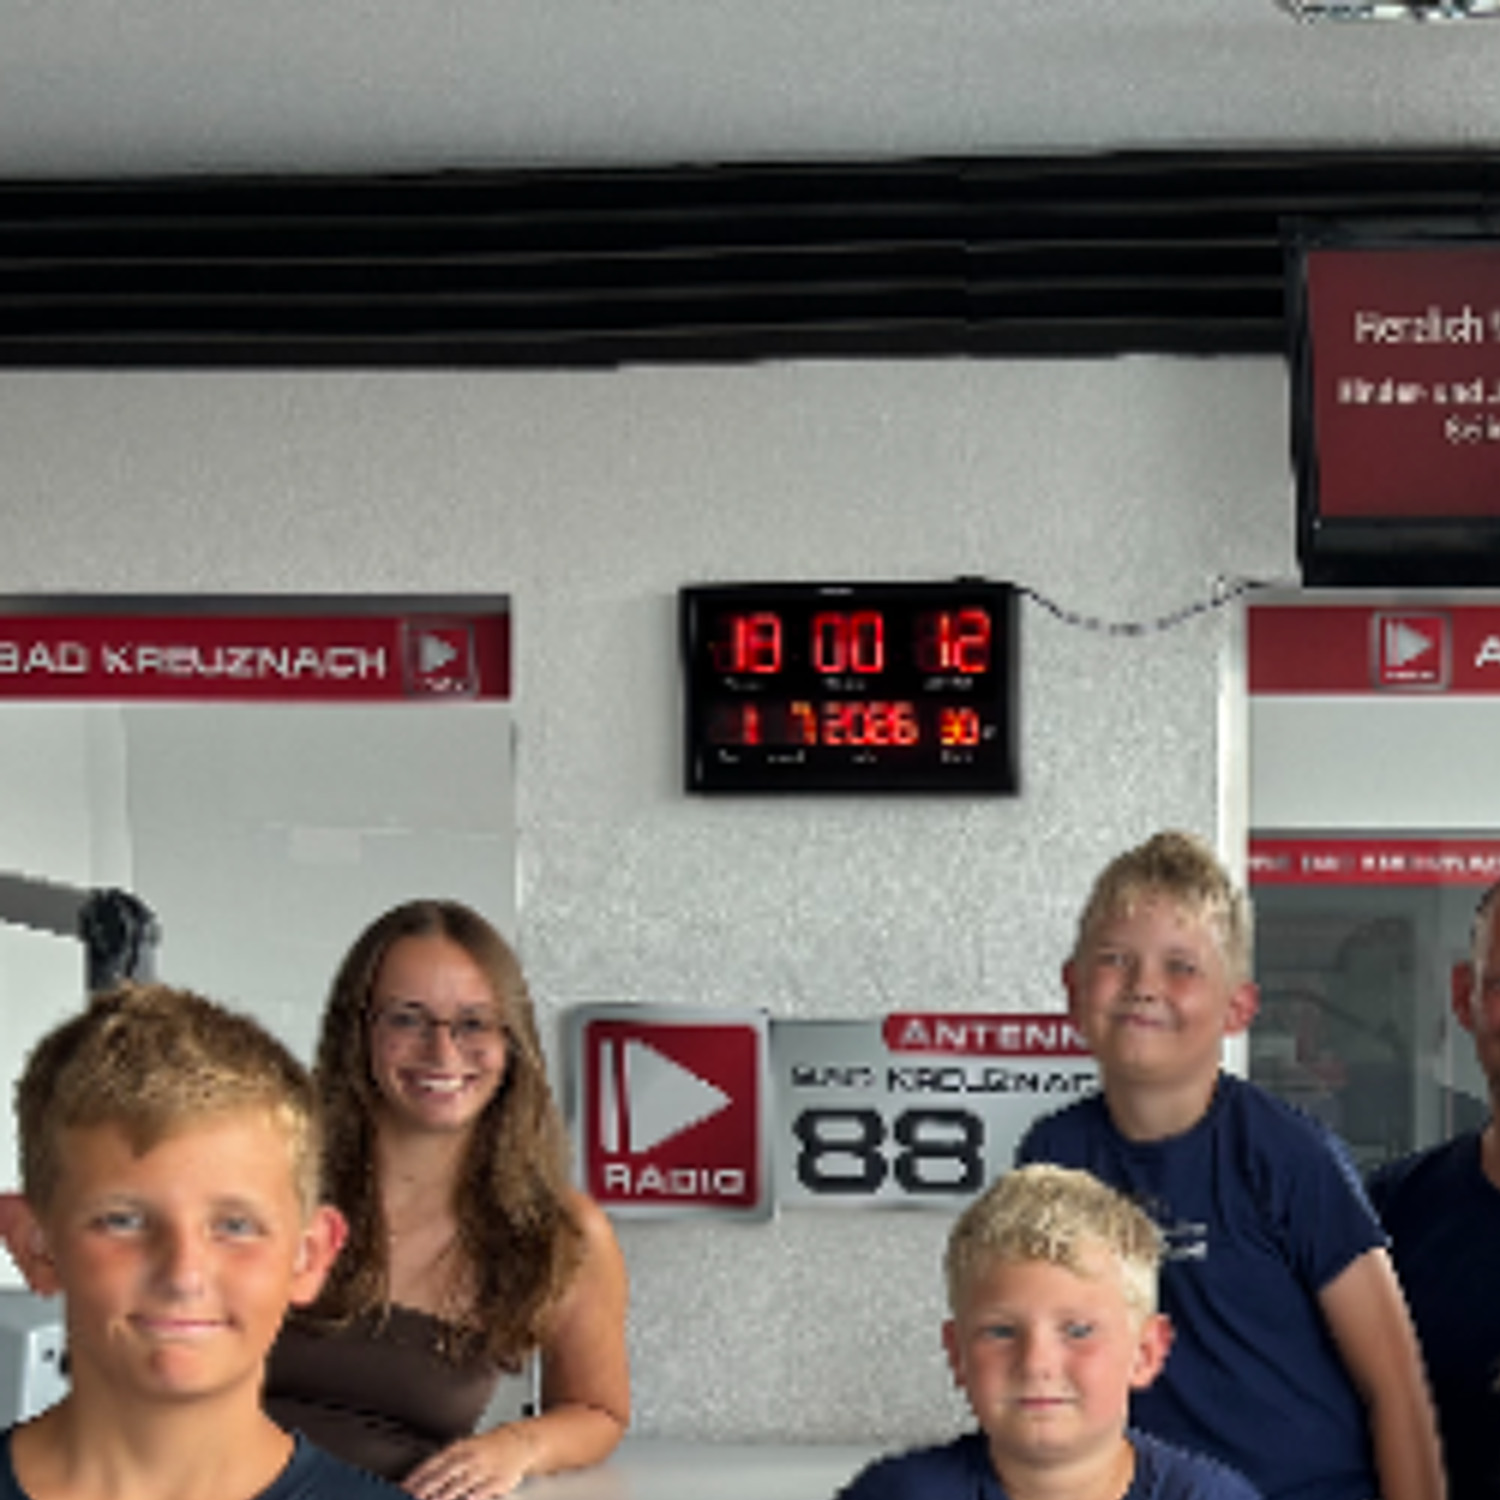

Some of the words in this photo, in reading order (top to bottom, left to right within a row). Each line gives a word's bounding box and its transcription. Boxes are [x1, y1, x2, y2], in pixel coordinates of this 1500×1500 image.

[812, 610, 884, 674] 00
[938, 606, 992, 675] 12
[102, 644, 387, 680] KREUZNACH
[903, 1019, 1089, 1051] ANTENN
[792, 1107, 986, 1196] 88
[603, 1163, 745, 1198] RADIO
